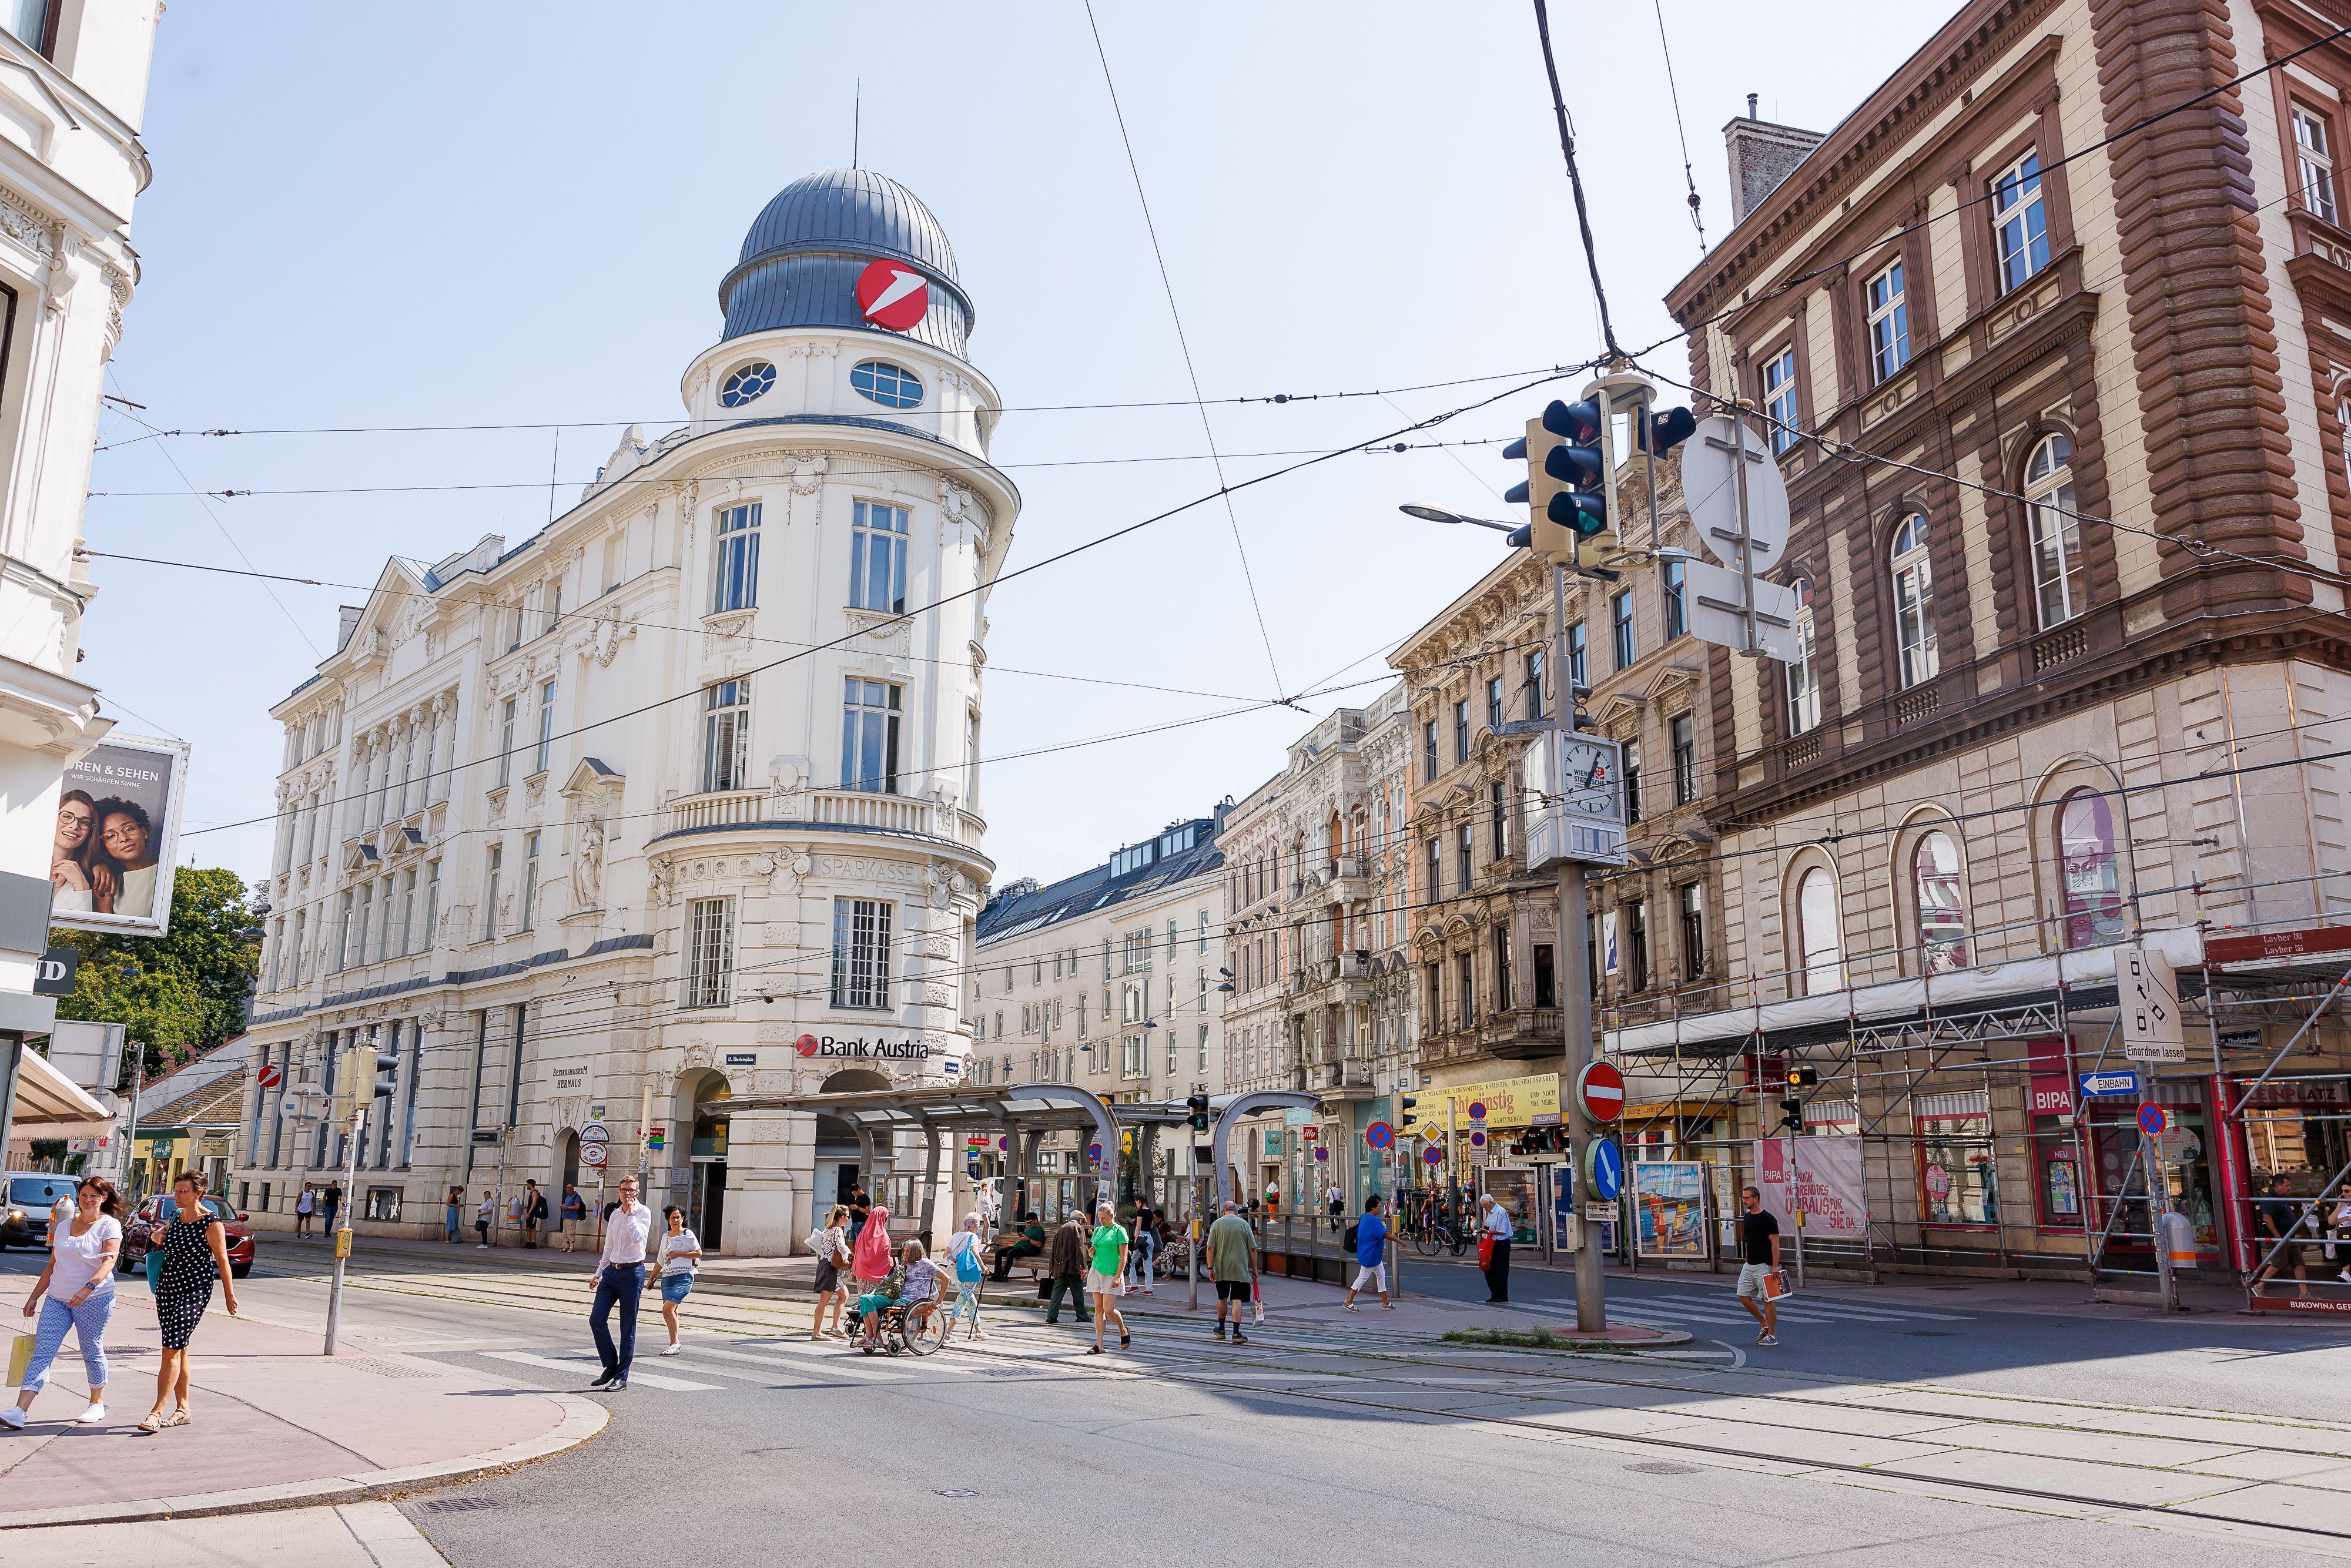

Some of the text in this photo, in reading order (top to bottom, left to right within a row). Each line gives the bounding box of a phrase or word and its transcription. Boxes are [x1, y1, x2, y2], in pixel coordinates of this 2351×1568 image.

[1659, 414, 1667, 423] 25
[68, 760, 159, 782] REN & SEHEN
[85, 775, 119, 785] SCHÄRFEN
[120, 780, 142, 789] SINNE.
[822, 858, 914, 882] SPARKASSE
[2263, 932, 2291, 944] Layher
[2265, 944, 2292, 955] Layher
[821, 1036, 929, 1059] Bank Austria
[2126, 1044, 2184, 1058] Einordnen lassen
[557, 1078, 581, 1088] HERNALS
[1512, 1075, 1555, 1086] HAUSHALTSWAREN
[2098, 1078, 2130, 1089] EINBAHN
[2036, 1091, 2071, 1109] BIPA
[1626, 1107, 1640, 1117] günstig
[1493, 1115, 1523, 1124] NÄHZUBEHÖR
[1304, 1128, 1315, 1139] illy
[582, 1144, 605, 1152] STRASSENBAHN
[2054, 1150, 2068, 1159] NEU
[1657, 1174, 1694, 1182] Geschmack!
[1764, 1170, 1782, 1180] BIPA
[1796, 1171, 1813, 1183] AUCH
[1816, 1184, 1829, 1196] DES
[1785, 1197, 1843, 1215] UBAUS FÜR
[1588, 1211, 1616, 1219] Linienomnibusse
[1829, 1211, 1857, 1229] SIE DA.
[2290, 1301, 2335, 1310] BUKOWINA
